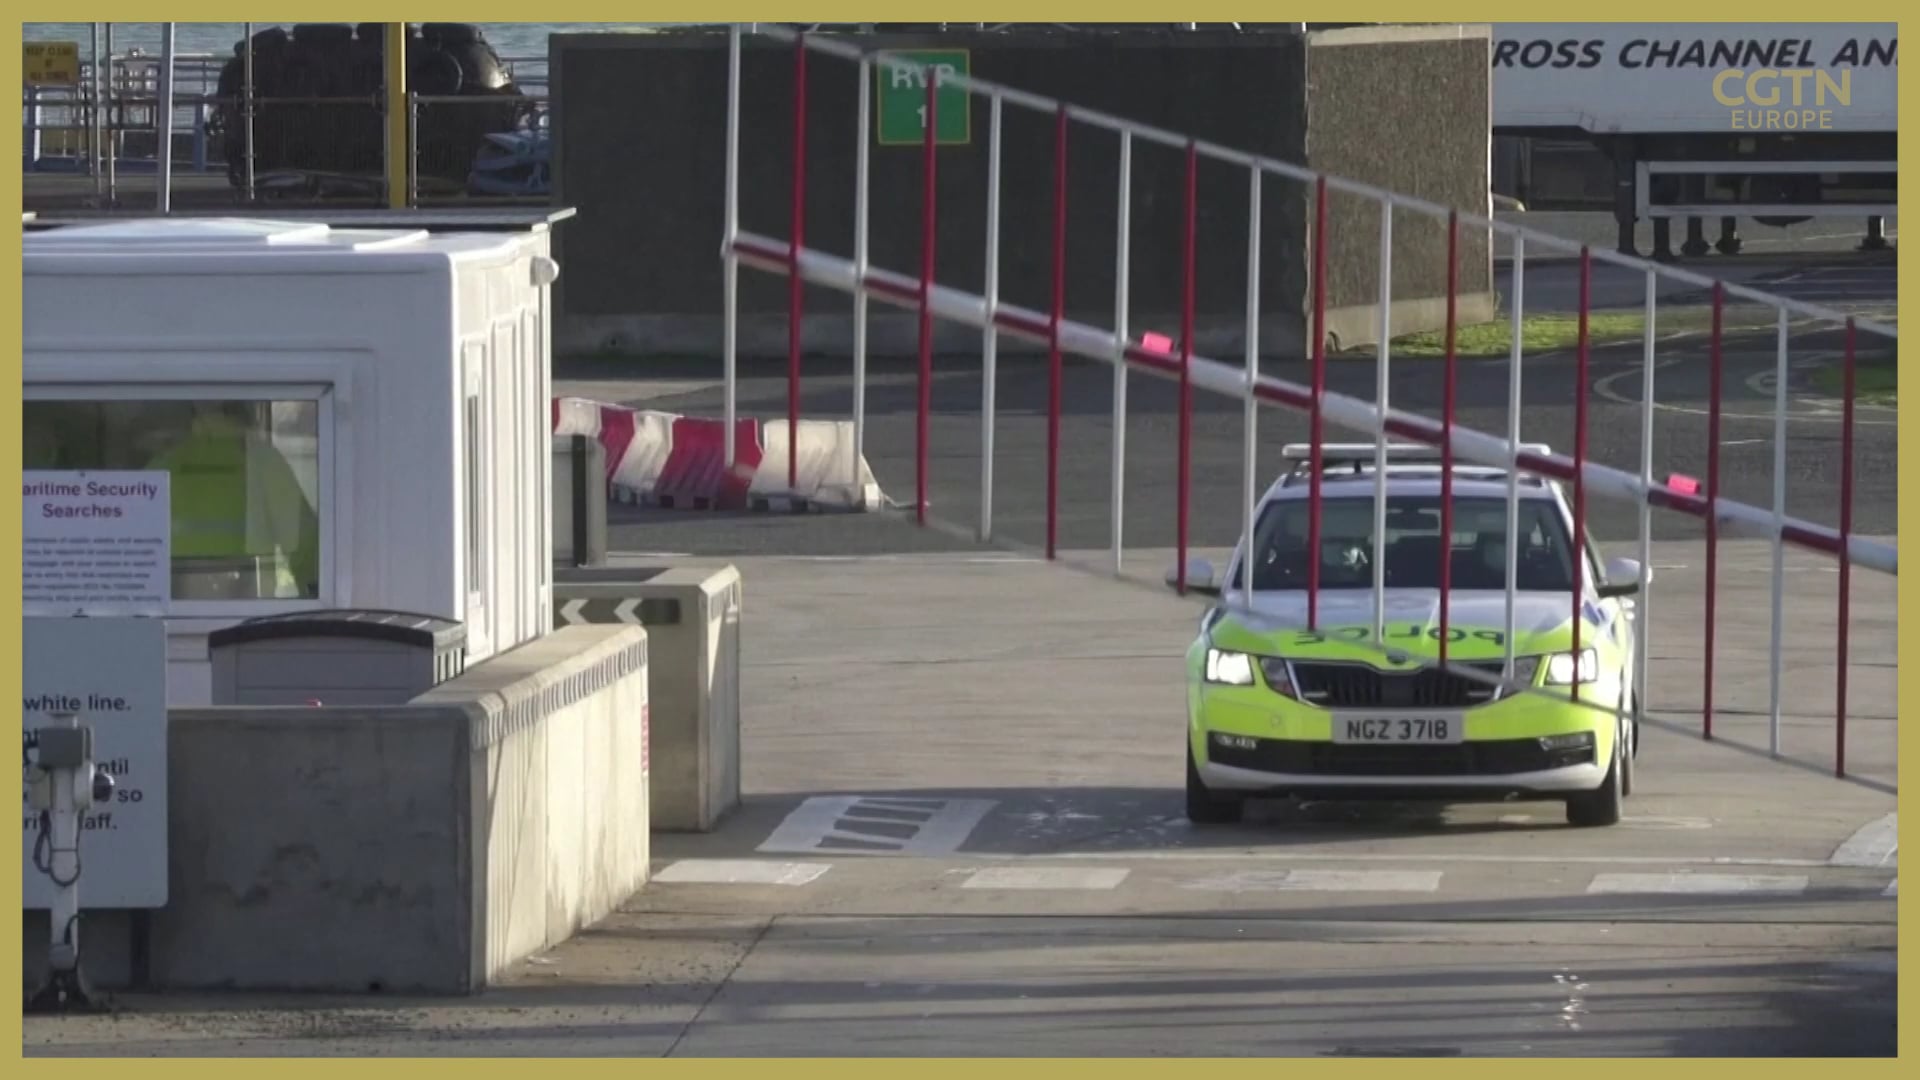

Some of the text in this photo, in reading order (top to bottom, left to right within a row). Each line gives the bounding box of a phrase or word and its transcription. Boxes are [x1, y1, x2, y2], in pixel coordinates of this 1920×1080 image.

[1492, 38, 1898, 69] ROSS CHANNEL AN
[891, 63, 955, 88] RVP
[917, 104, 928, 128] 1
[22, 480, 158, 500] aritime Security
[42, 503, 123, 518] Searches
[23, 694, 131, 711] white line.
[1346, 719, 1449, 742] NGZ 3718
[96, 758, 129, 775] ntil
[117, 789, 144, 803] so
[80, 812, 117, 830] aff.
